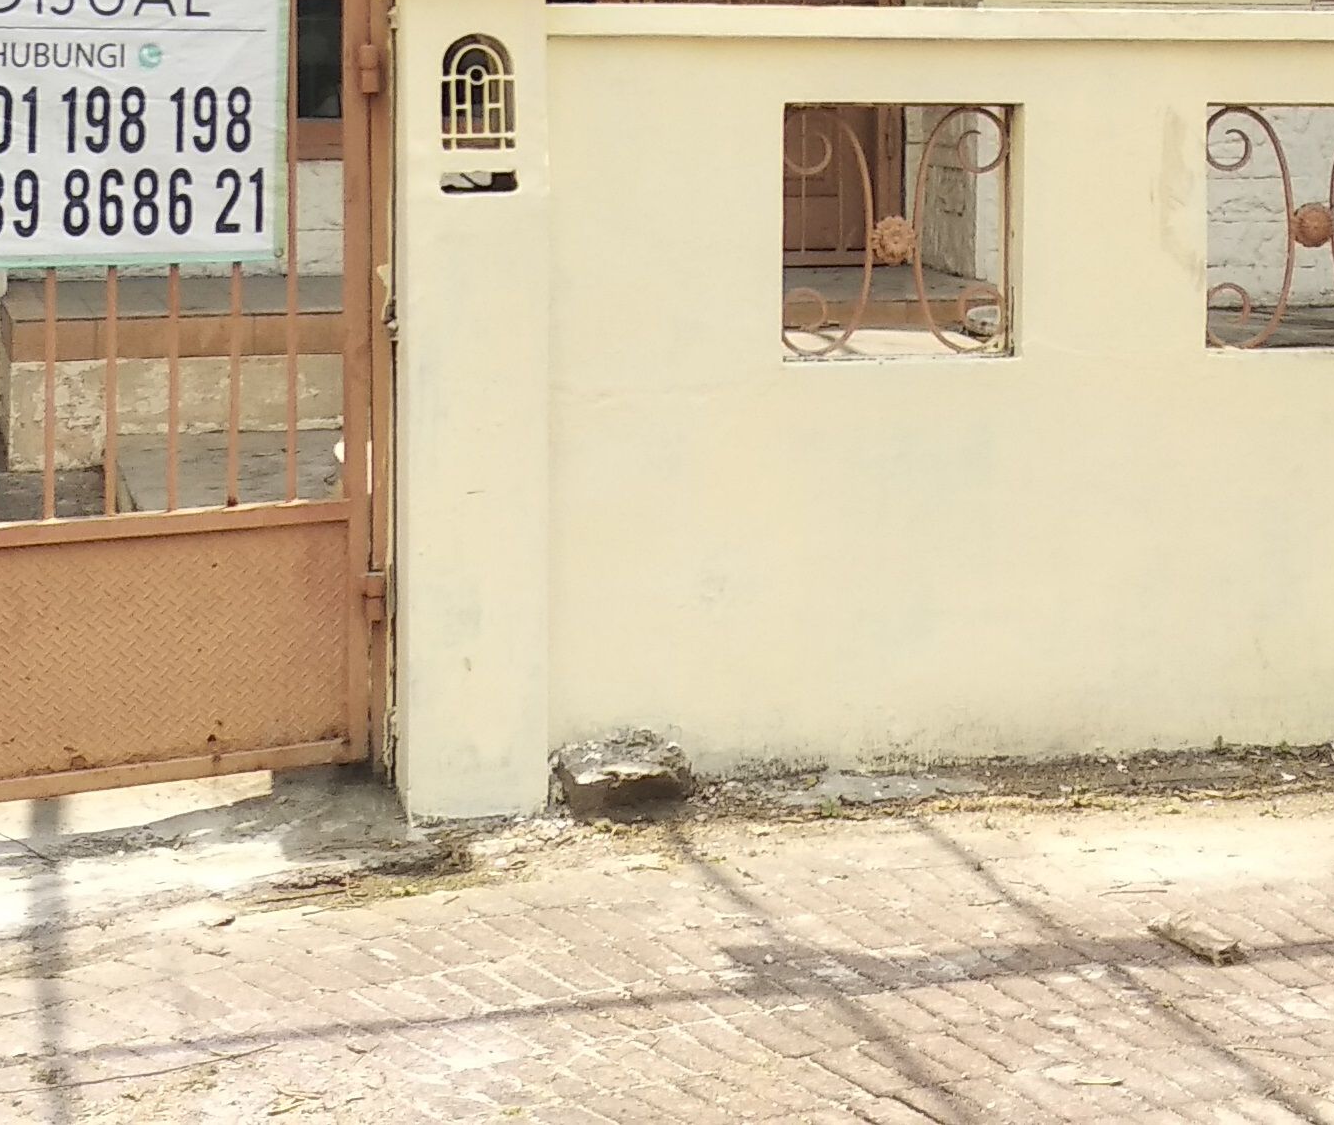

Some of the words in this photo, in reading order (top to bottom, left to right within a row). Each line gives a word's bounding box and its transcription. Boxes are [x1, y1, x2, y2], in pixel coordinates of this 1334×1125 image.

[62, 86, 146, 154] 198
[170, 86, 251, 154] 198
[62, 168, 193, 237] 8686
[215, 167, 265, 234] 21
